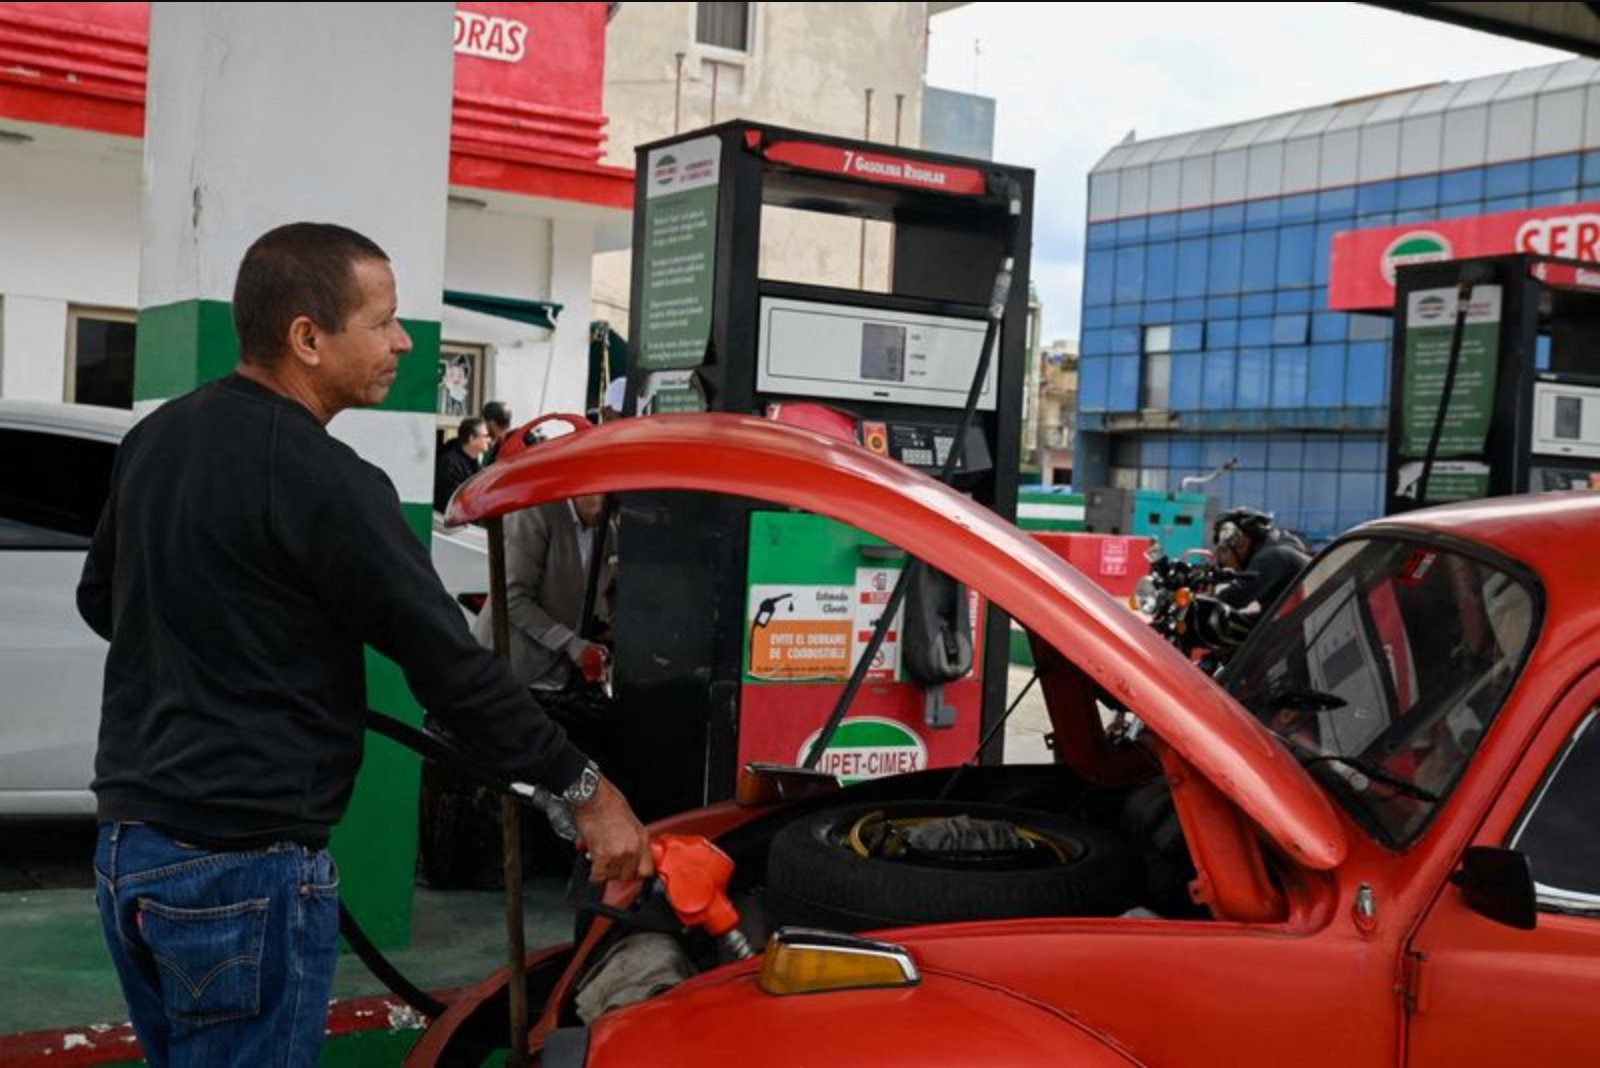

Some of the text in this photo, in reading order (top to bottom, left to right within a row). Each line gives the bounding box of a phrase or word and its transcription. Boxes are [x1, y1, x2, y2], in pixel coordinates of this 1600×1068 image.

[843, 150, 946, 185] 7 GASOLINA REGULAR
[769, 647, 781, 659] DE
[817, 750, 919, 776] UPET-CIMEX
